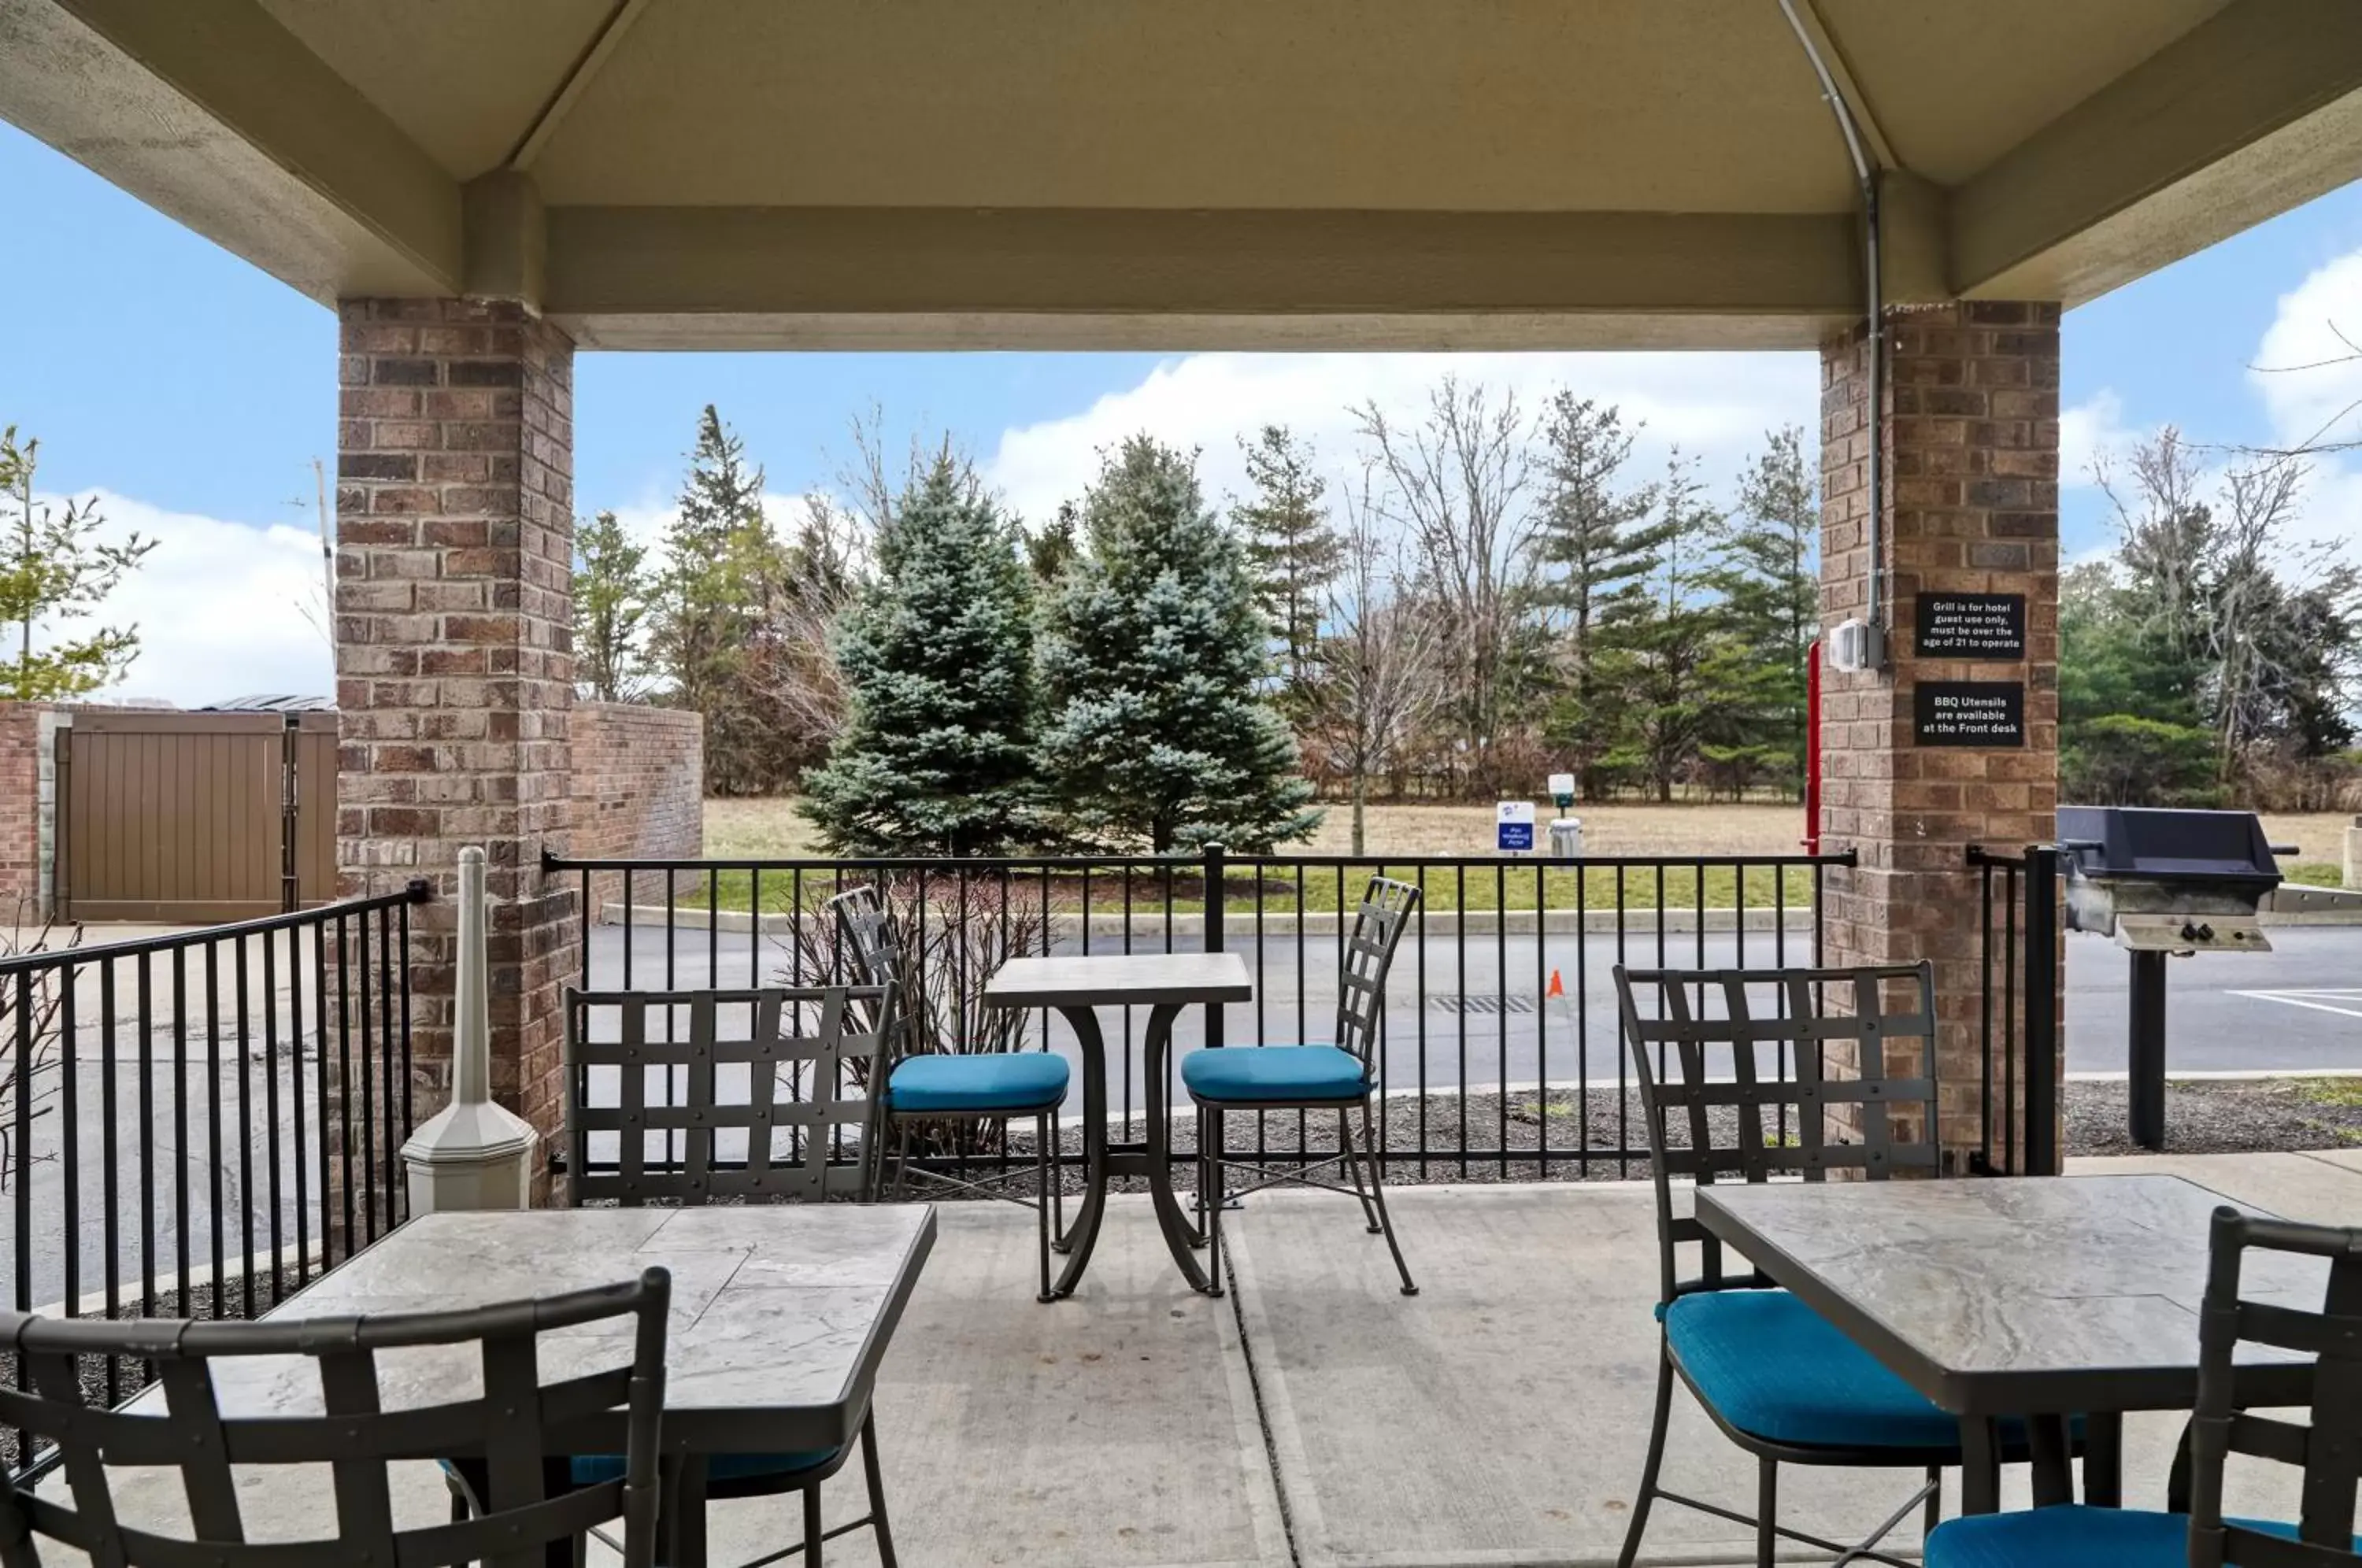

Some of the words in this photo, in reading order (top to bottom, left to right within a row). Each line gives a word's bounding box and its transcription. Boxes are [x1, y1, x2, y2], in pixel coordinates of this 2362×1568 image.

[1934, 602, 1955, 611] Grill
[1986, 604, 2010, 612] hotel
[1934, 615, 1962, 624] guest
[1996, 627, 2012, 635] the
[1943, 638, 1953, 646] of
[1956, 638, 1965, 646] 21
[1982, 640, 2019, 649] operate
[1934, 697, 1958, 708] BBQ
[1961, 697, 2006, 707] Utensils
[1957, 710, 2005, 719] available
[1938, 723, 1956, 733] the
[1959, 723, 1988, 733] Front
[1991, 724, 2016, 733] desk
